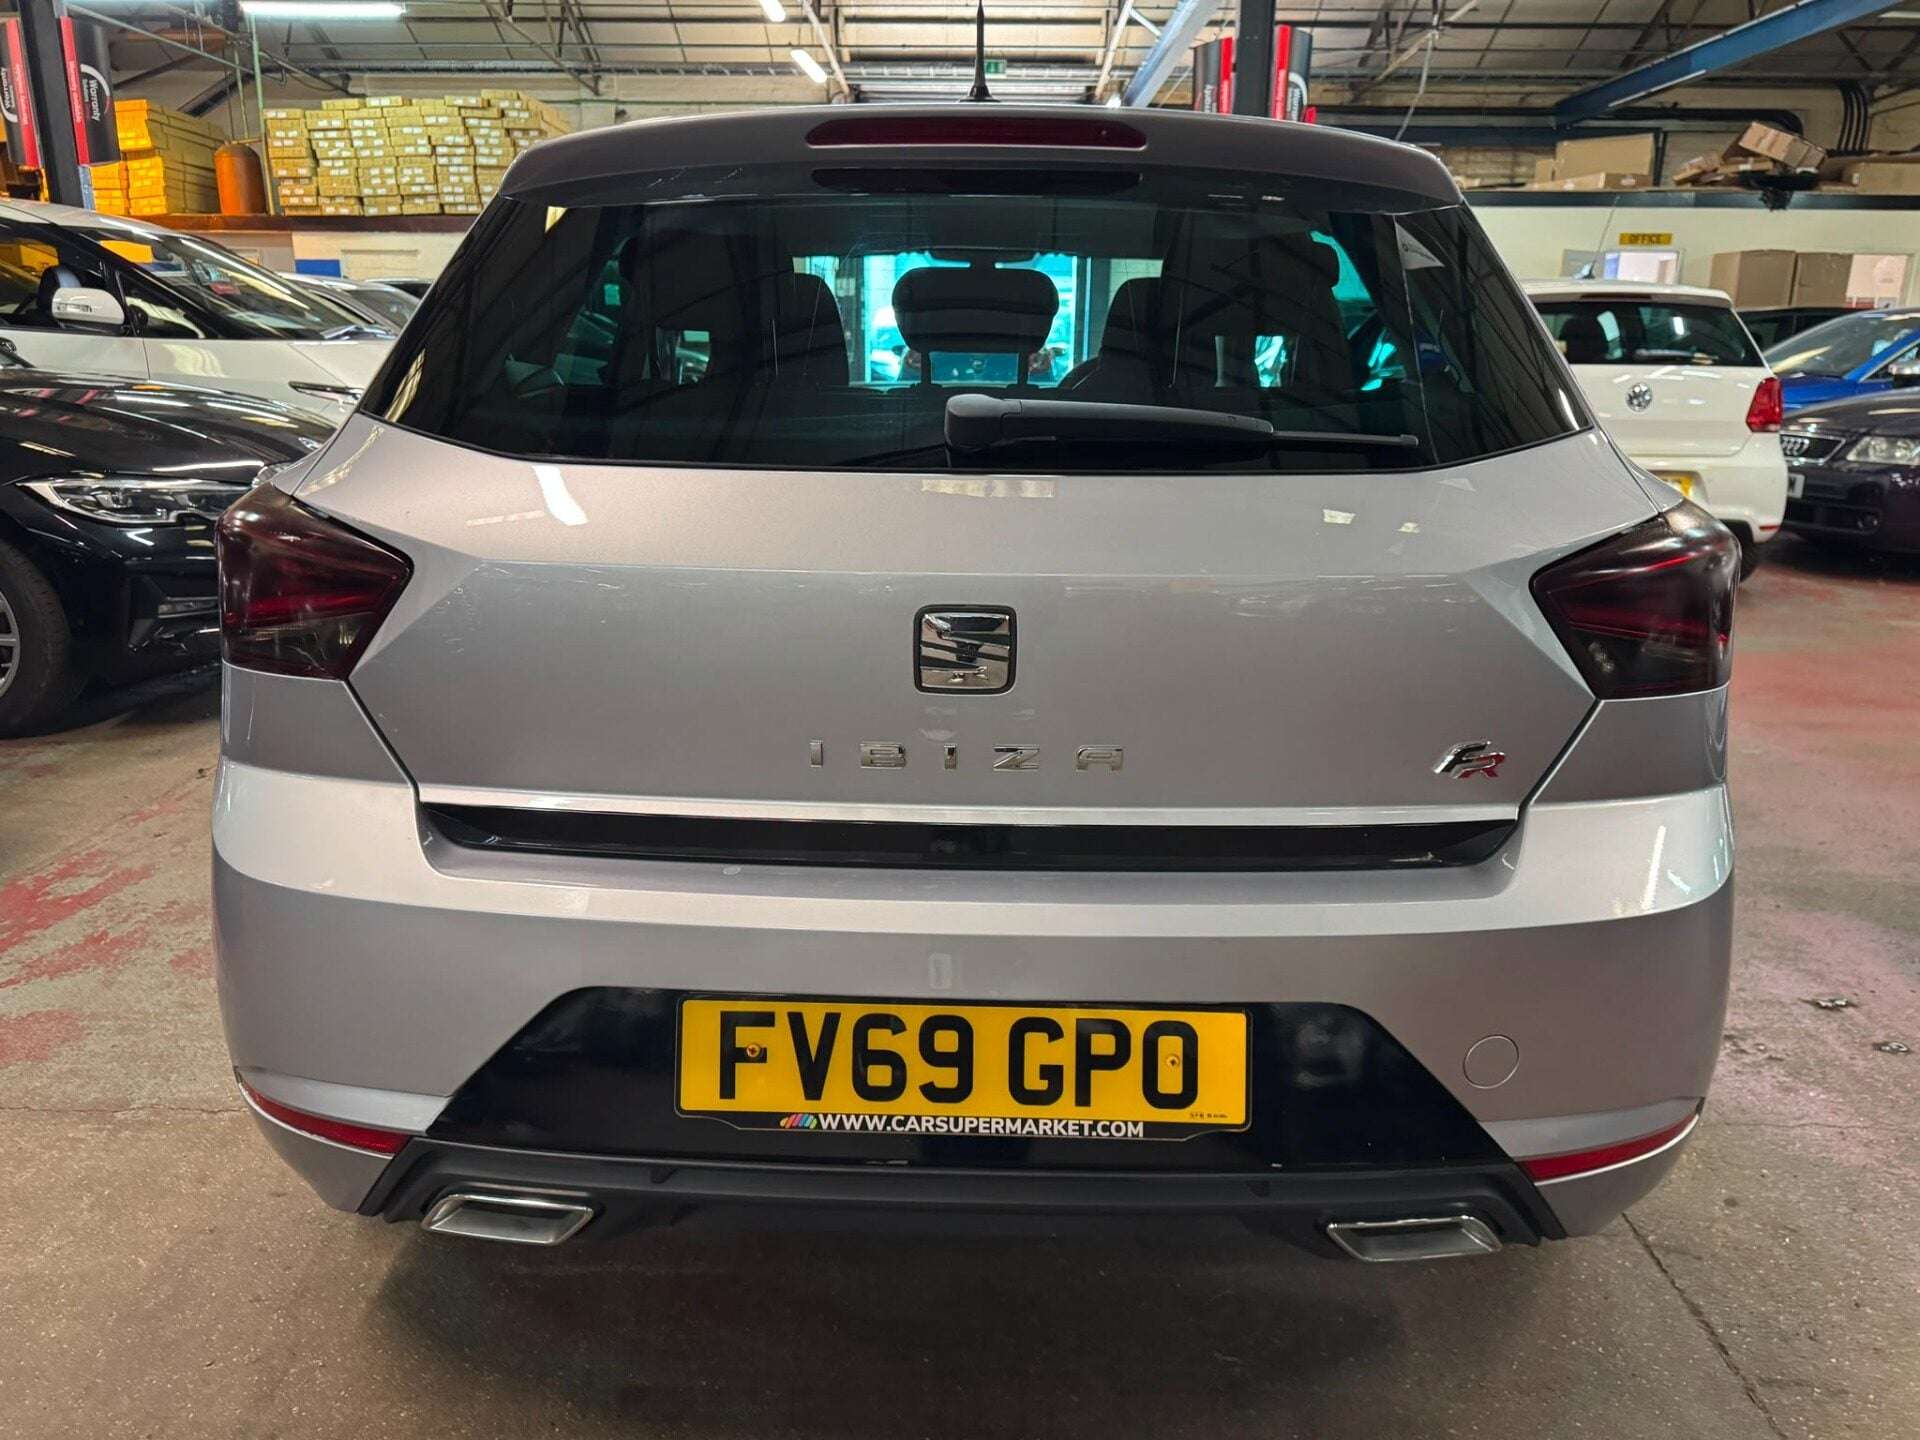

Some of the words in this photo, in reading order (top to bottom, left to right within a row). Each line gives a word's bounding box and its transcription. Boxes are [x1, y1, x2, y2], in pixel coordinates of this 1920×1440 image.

[88, 79, 101, 121] Warranty
[1629, 233, 1663, 245] OFFICE
[810, 740, 1124, 771] IBIZA
[1433, 740, 1505, 779] FR
[719, 1011, 974, 1103] FV69
[1008, 1016, 1199, 1110] GPO
[819, 1113, 1144, 1138] WWW.CARSUPERMARKET.COM
